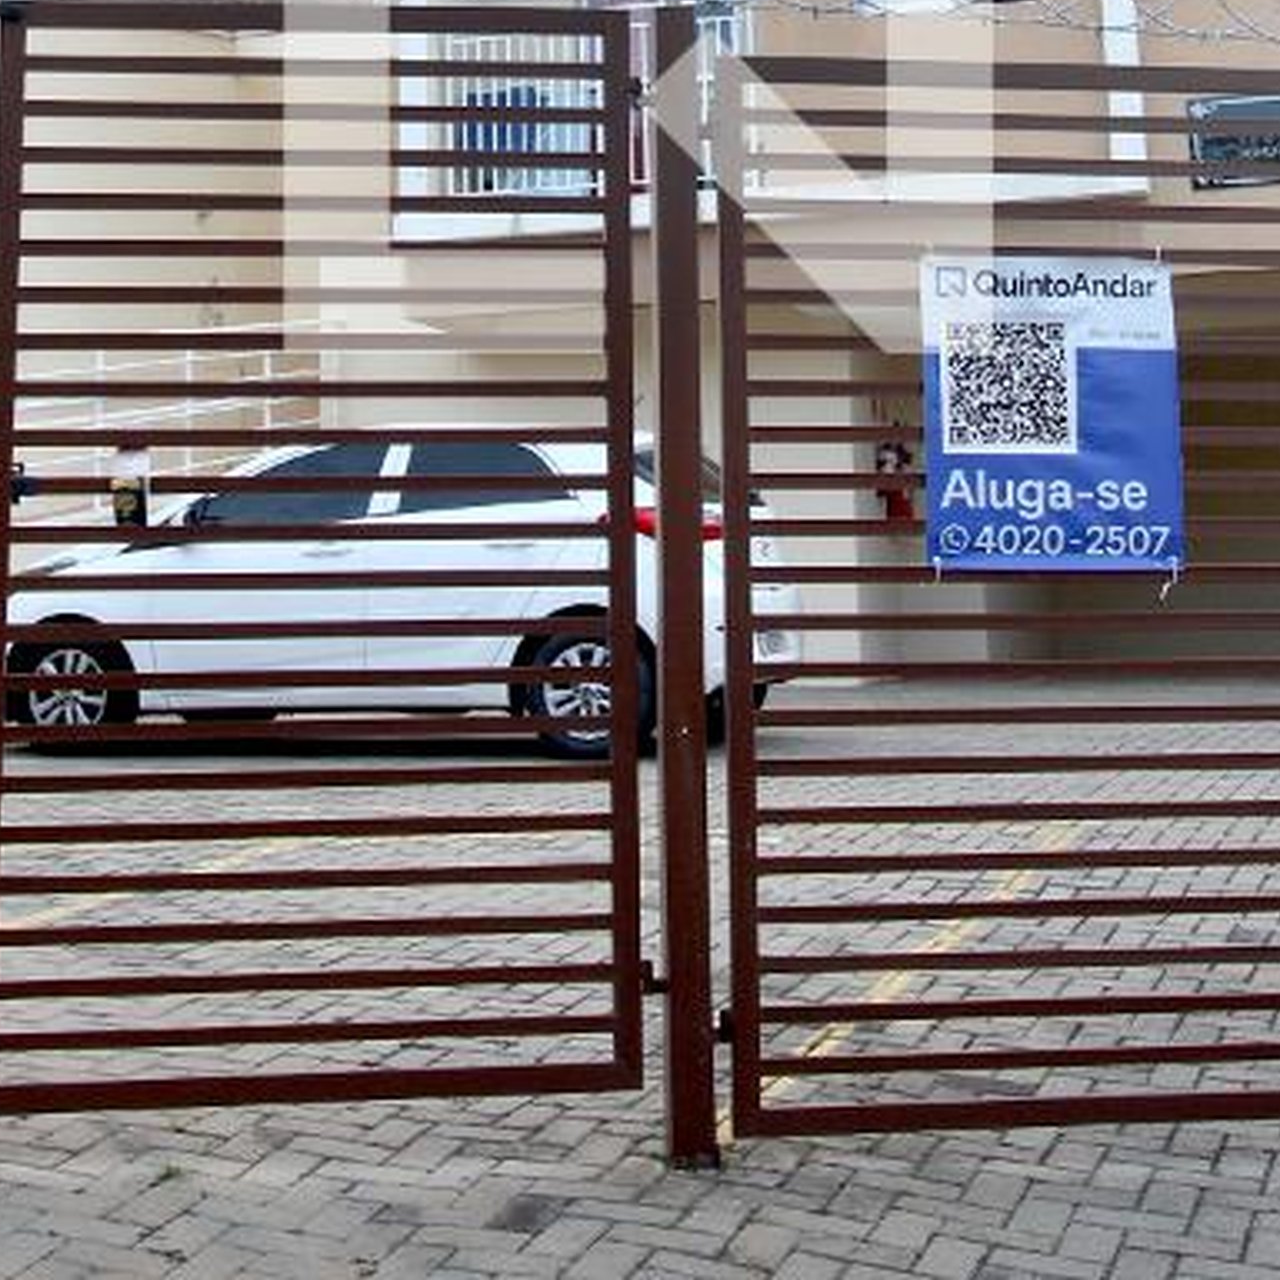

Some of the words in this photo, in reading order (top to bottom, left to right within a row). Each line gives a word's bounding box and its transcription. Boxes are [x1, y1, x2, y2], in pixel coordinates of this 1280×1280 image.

[972, 268, 1158, 298] QuintoAndar
[940, 469, 1148, 520] Aluga-se
[974, 524, 1170, 555] 4020-2507
